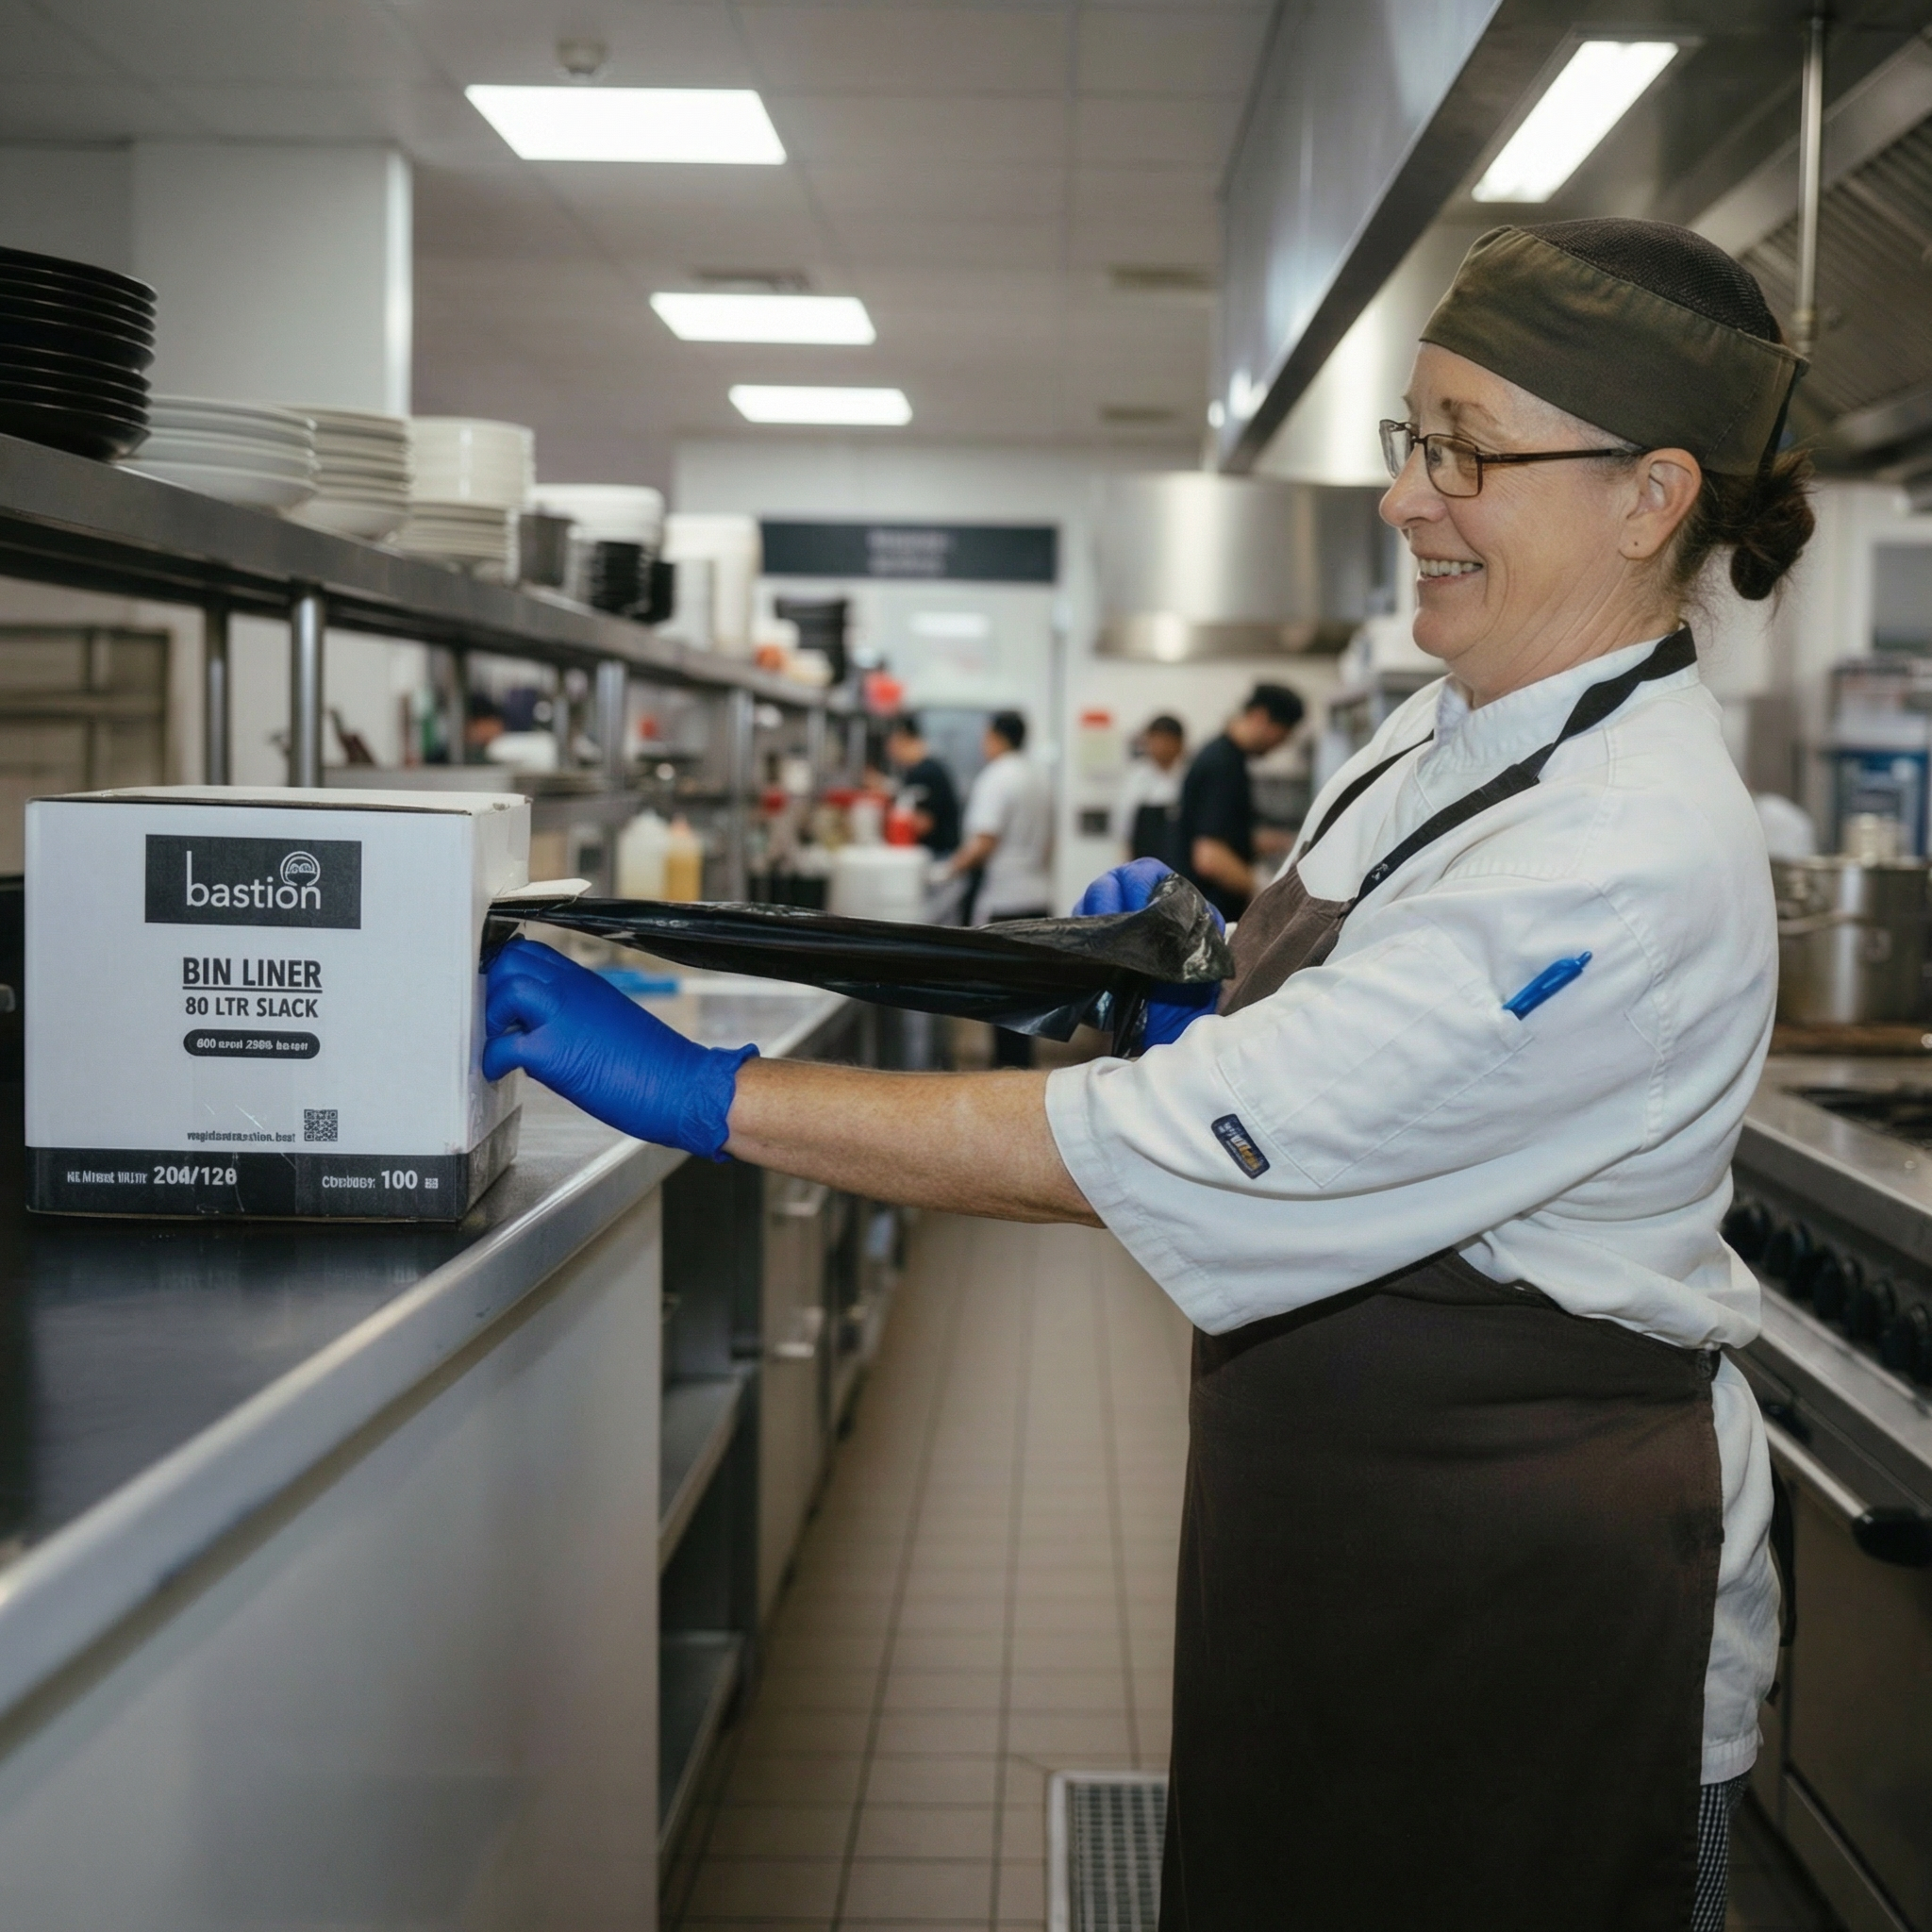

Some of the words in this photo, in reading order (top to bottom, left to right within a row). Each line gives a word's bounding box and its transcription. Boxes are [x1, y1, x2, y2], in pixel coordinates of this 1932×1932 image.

[186, 850, 322, 909] bastion
[183, 957, 232, 986] BIN
[242, 958, 323, 989] LINER
[185, 996, 209, 1016] 80
[215, 996, 250, 1017] LTR
[256, 997, 319, 1019] SLACK
[381, 1170, 418, 1190] 100
